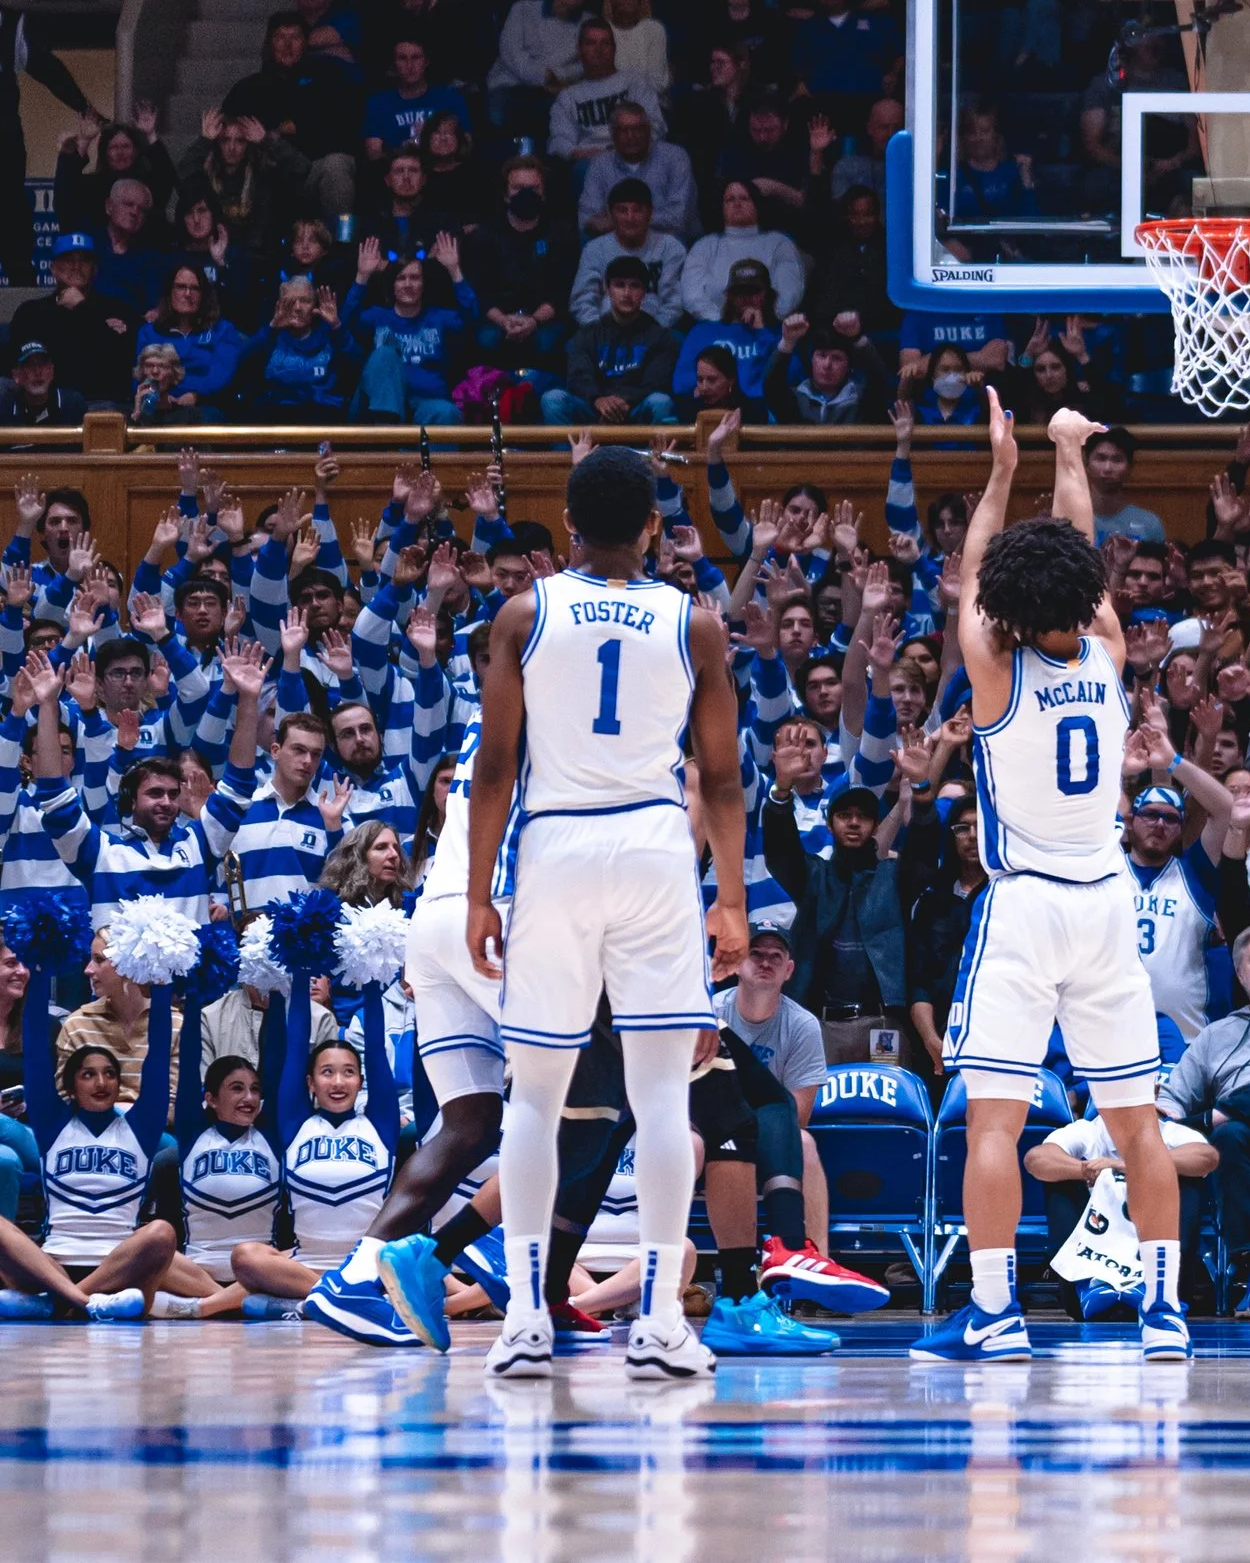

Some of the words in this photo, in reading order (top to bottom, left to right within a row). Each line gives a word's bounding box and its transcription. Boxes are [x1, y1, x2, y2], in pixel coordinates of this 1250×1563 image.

[931, 269, 994, 283] SPALDING
[934, 326, 986, 342] DUKE
[570, 601, 656, 635] FOSTER
[592, 638, 621, 735] 1
[1056, 715, 1100, 796] 0
[821, 1071, 897, 1108] DUKE
[55, 1146, 137, 1182] DUKE
[193, 1148, 274, 1184] DUKE
[294, 1135, 377, 1170] DUKE
